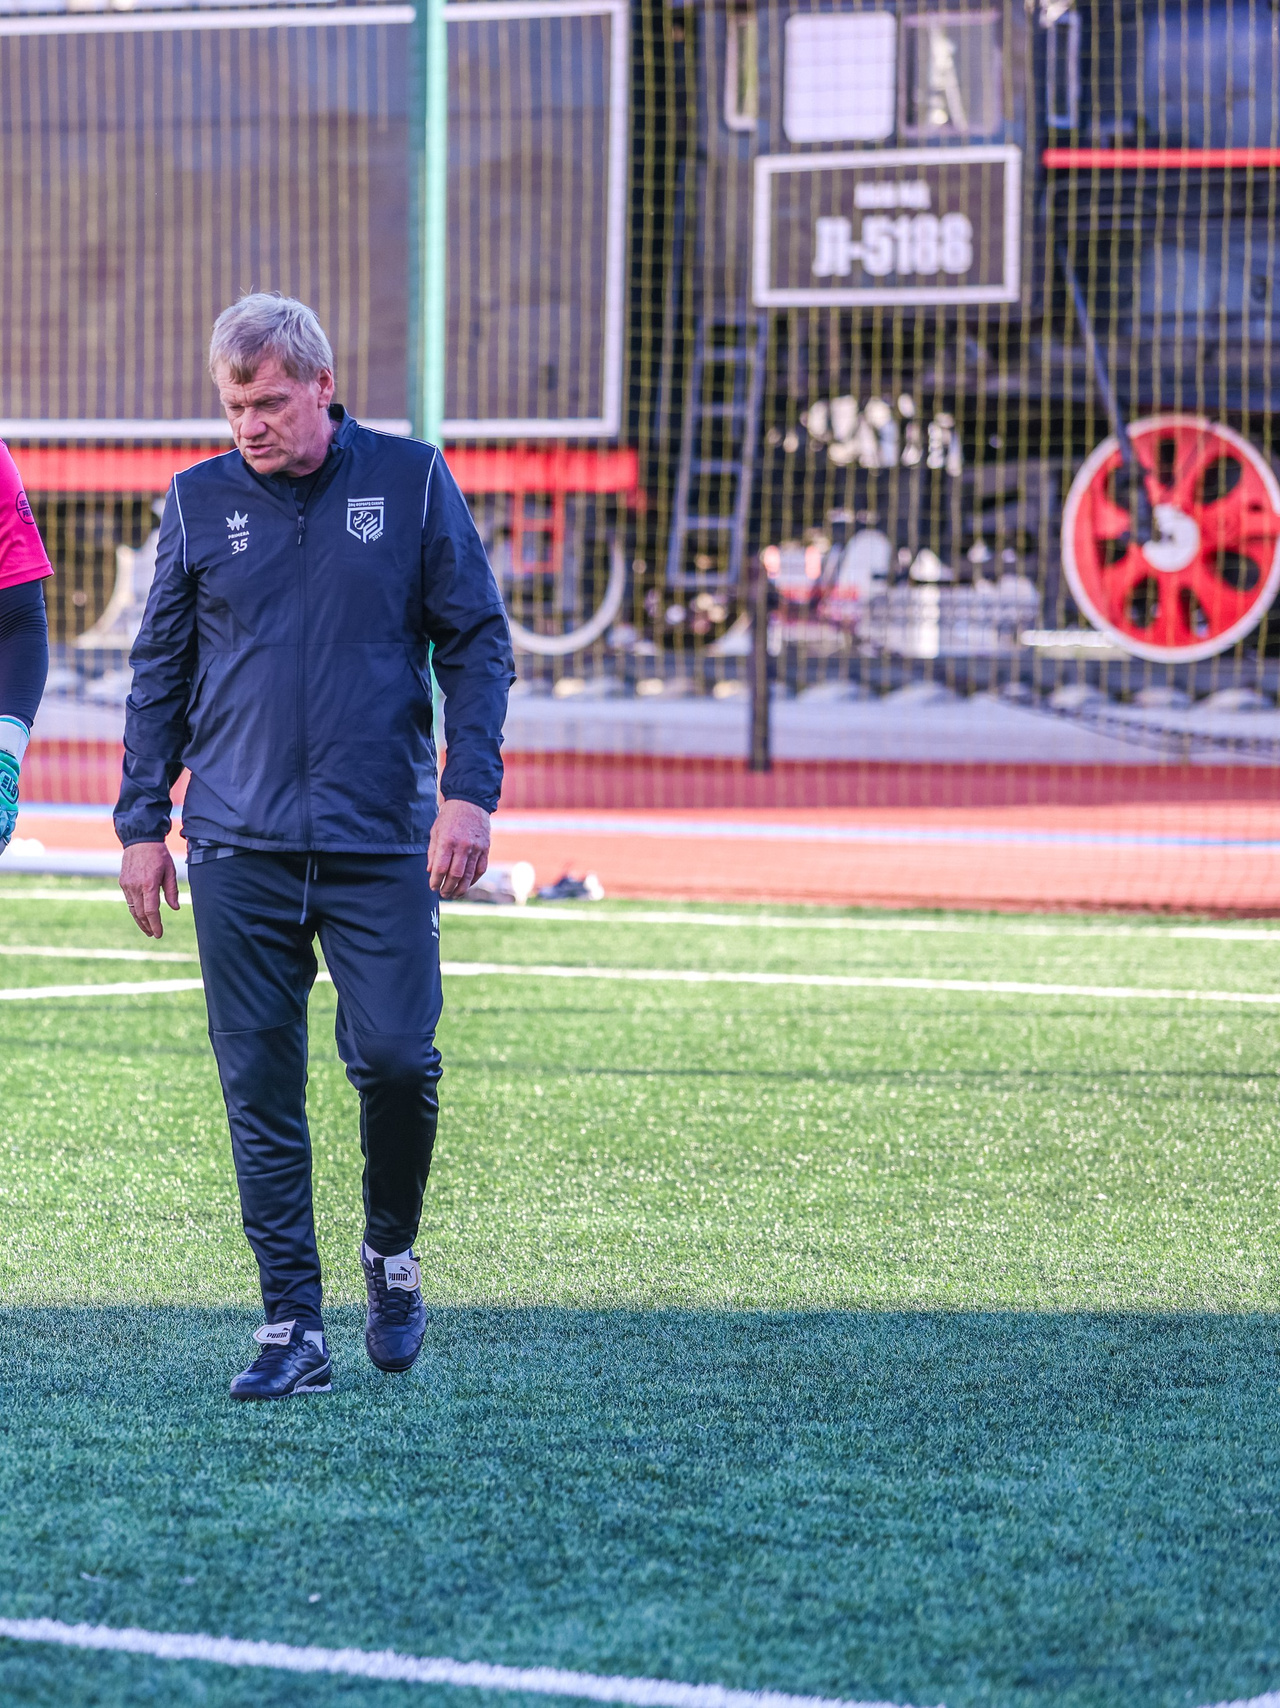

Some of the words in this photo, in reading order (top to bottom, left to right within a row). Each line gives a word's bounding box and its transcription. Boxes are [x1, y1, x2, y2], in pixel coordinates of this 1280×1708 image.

[231, 537, 248, 554] 35
[388, 1272, 408, 1281] PUMA
[266, 1331, 289, 1339] PUMA
